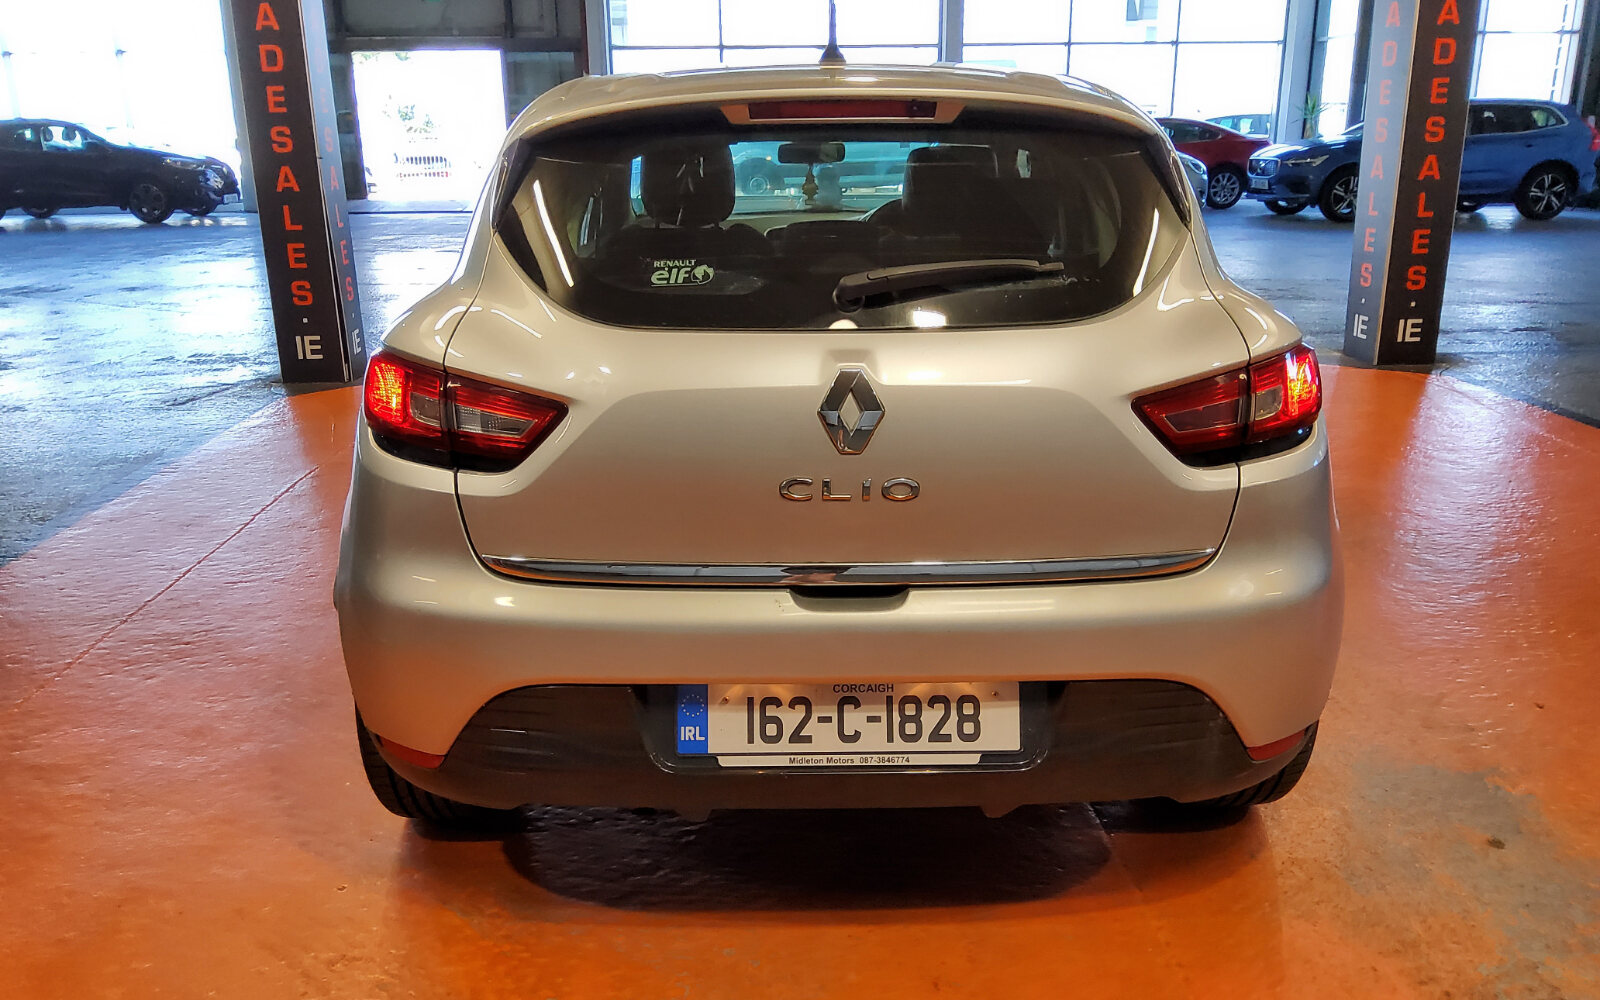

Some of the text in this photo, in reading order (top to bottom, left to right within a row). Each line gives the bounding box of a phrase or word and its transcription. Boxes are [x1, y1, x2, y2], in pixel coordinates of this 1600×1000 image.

[653, 259, 697, 268] RENAULT
[779, 477, 920, 502] CLIO
[832, 683, 894, 693] CORCAIGH
[747, 695, 981, 744] 162-C-1828
[680, 726, 705, 741] IRL
[789, 757, 824, 765] Midleton
[859, 756, 910, 764] 087-3846774
